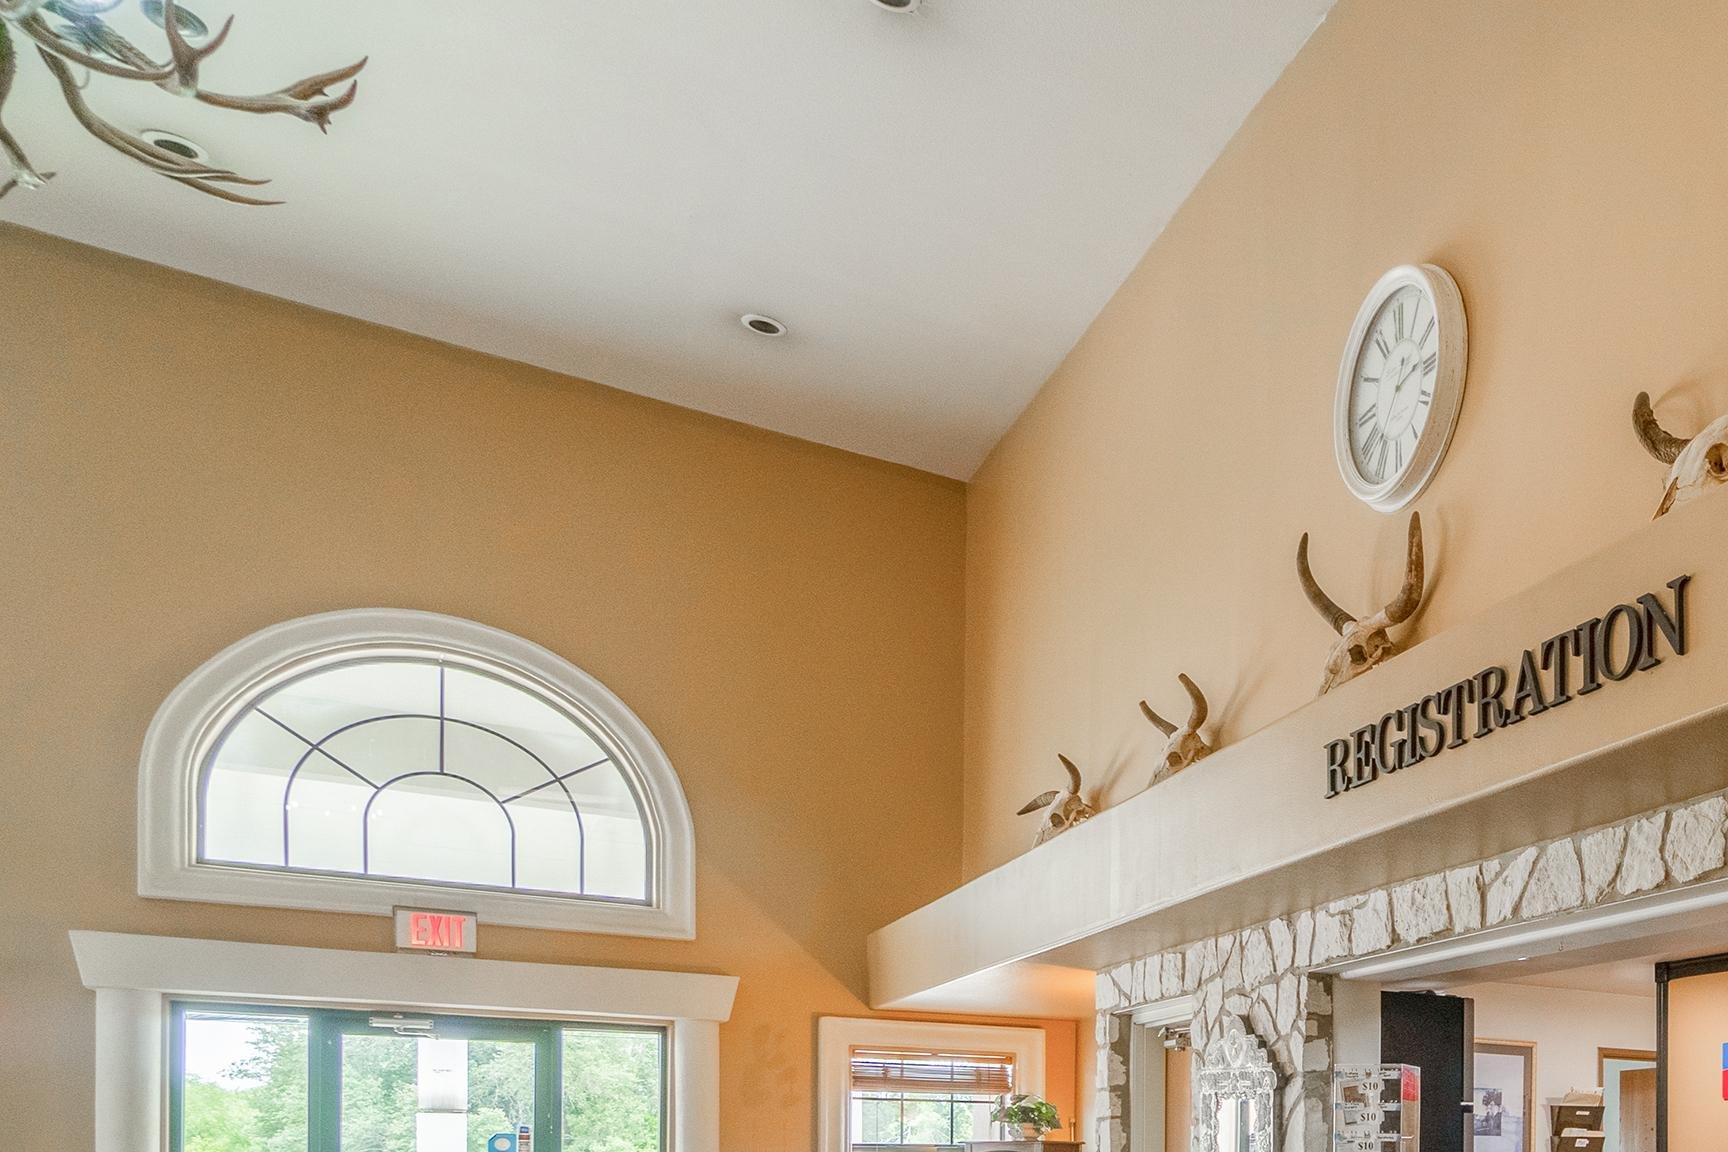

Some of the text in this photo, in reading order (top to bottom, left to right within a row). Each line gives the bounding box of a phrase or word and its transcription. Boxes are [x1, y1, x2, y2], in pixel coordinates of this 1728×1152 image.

[1324, 574, 1692, 800] REGISTRATION
[410, 913, 465, 948] EXIT
[1362, 1081, 1379, 1092] $10
[1360, 1112, 1377, 1122] $10
[1358, 1142, 1374, 1151] $10
